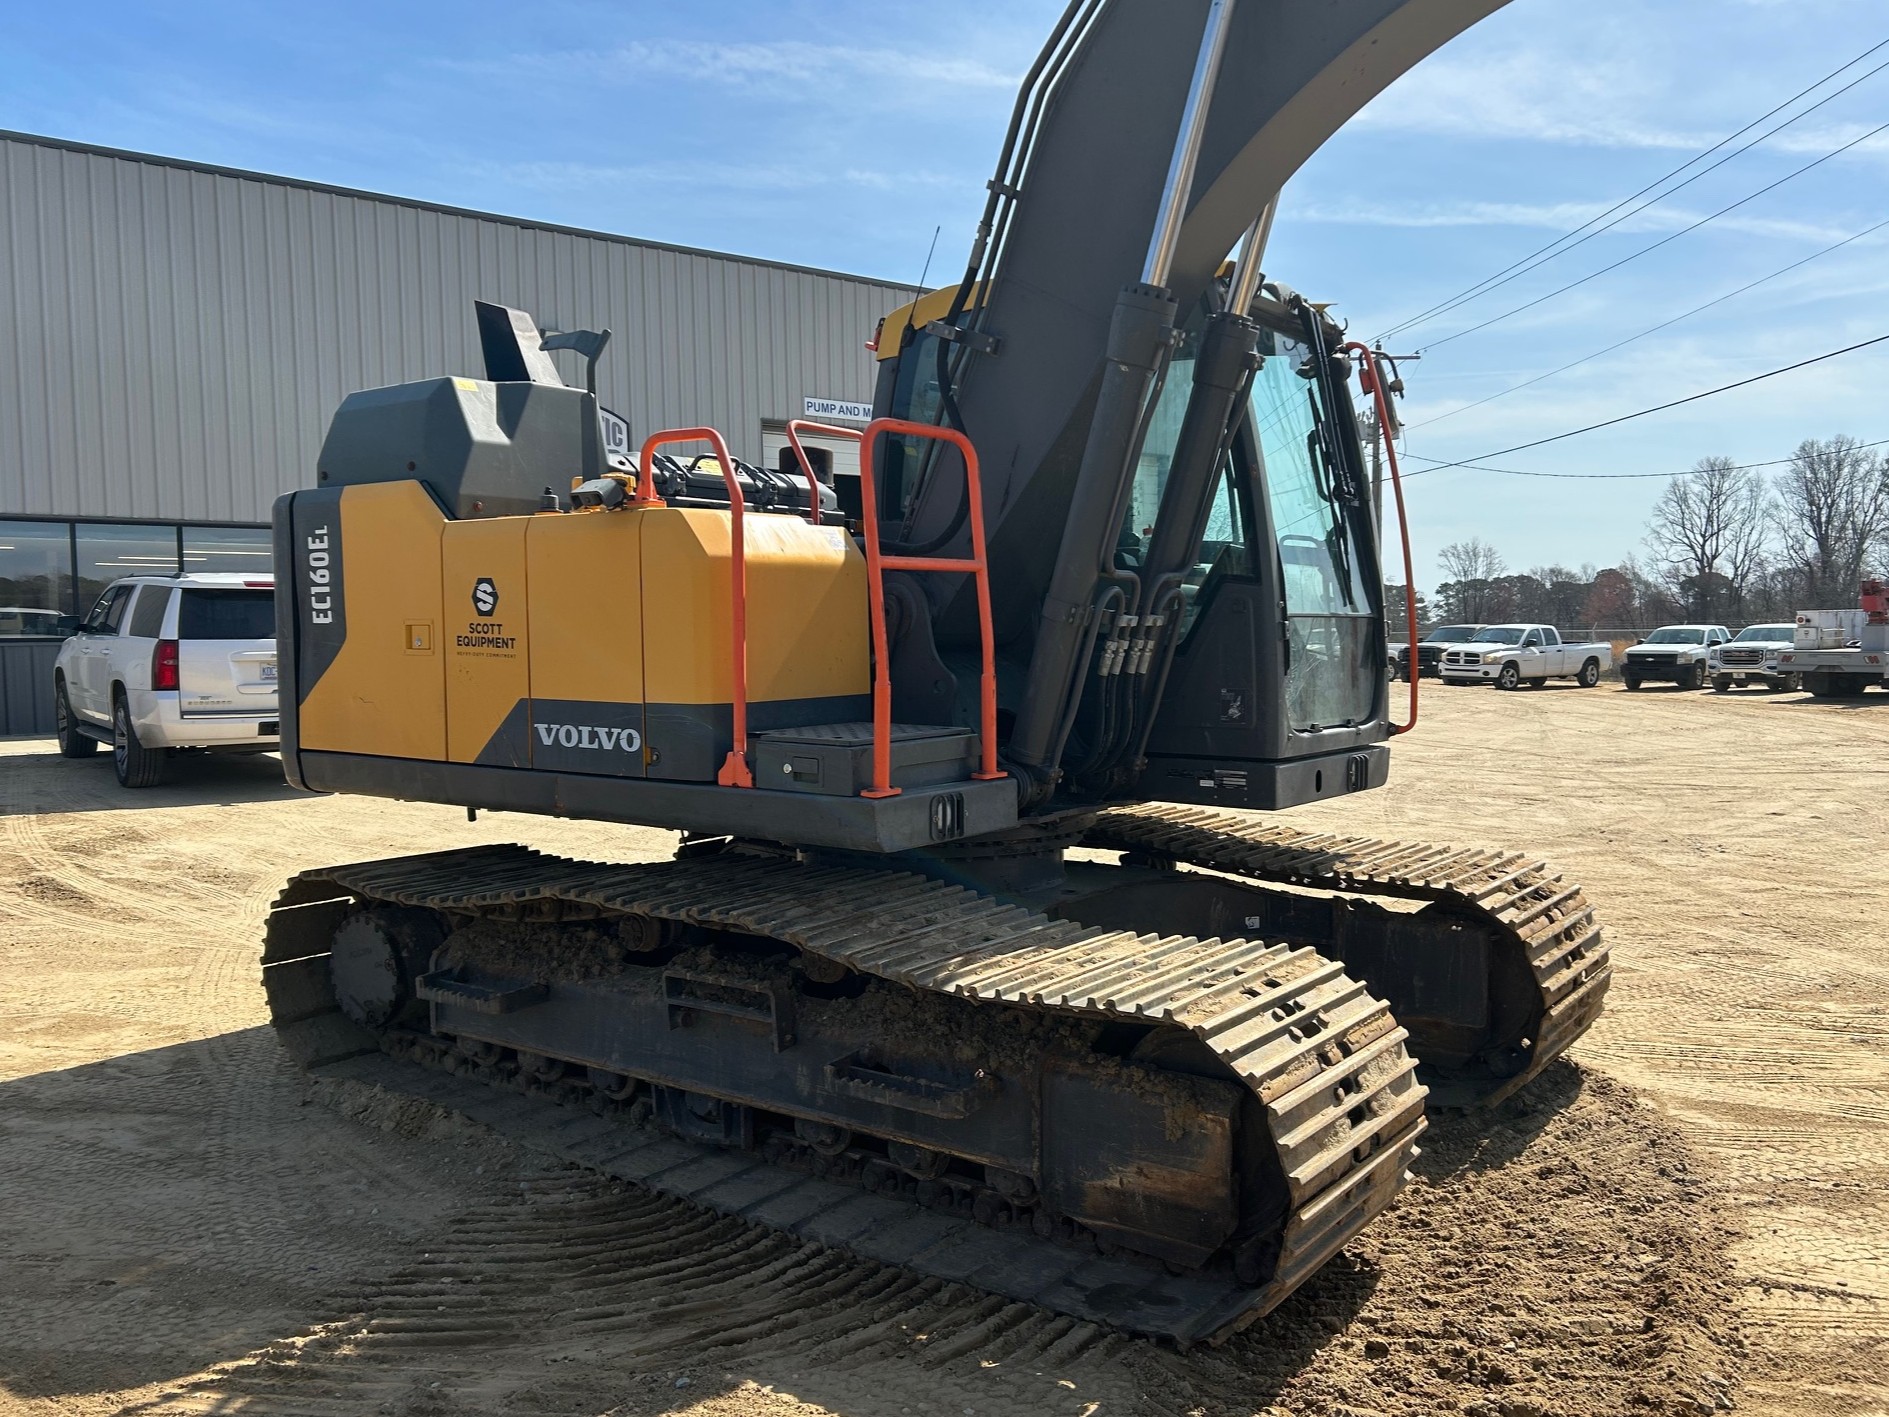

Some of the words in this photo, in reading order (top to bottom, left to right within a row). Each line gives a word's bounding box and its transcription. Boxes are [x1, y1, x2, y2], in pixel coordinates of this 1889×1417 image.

[806, 401, 836, 414] PUMP
[838, 405, 860, 416] AND
[863, 407, 874, 418] M
[601, 415, 623, 447] IC
[307, 525, 333, 624] EC160EL
[469, 623, 502, 634] SCOTT
[456, 635, 516, 649] EQUIPMENT
[534, 723, 641, 752] VOLVO
